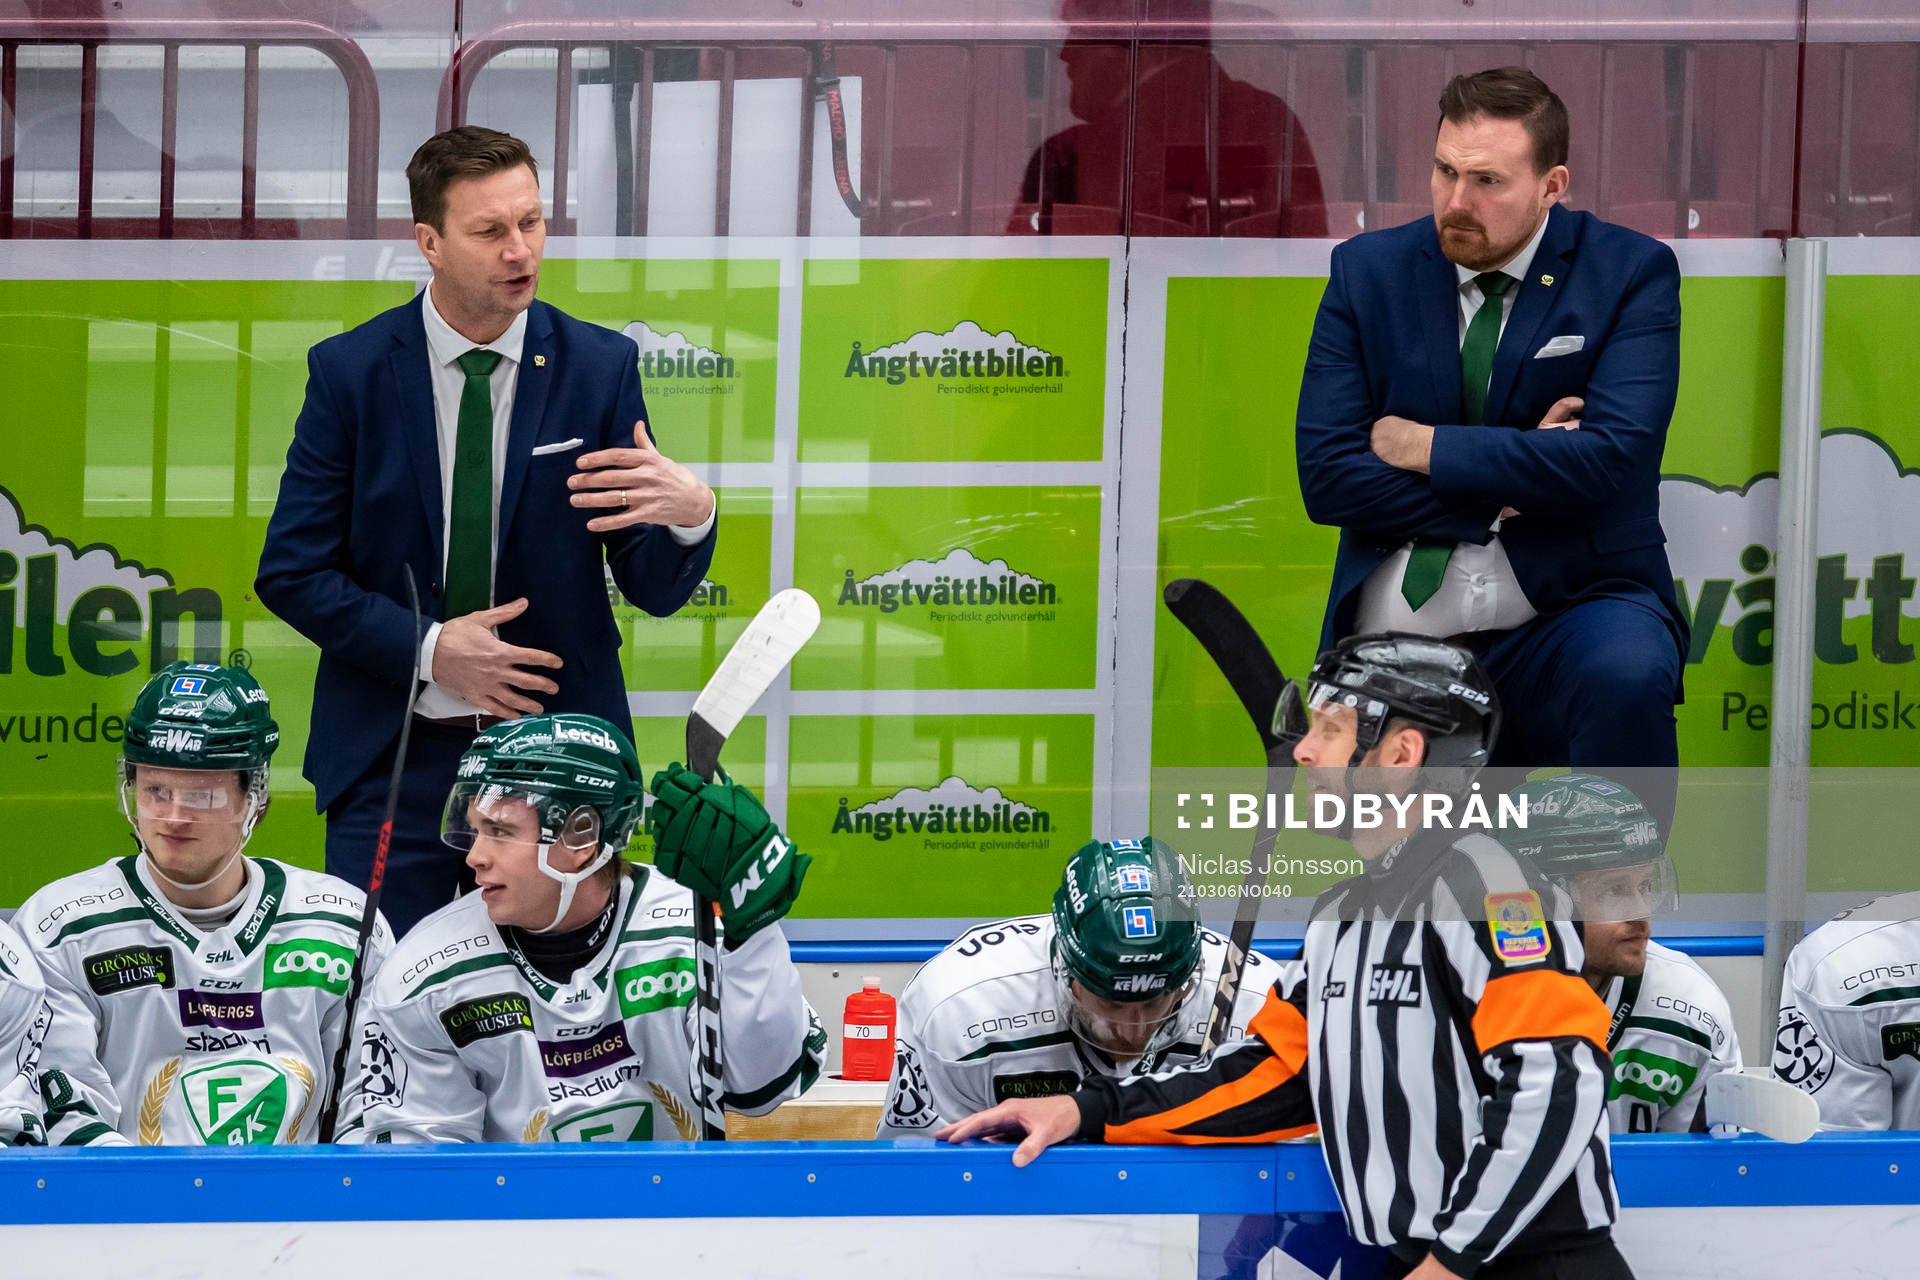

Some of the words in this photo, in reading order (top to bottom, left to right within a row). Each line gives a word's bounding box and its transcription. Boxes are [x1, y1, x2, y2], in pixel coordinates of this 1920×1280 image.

[844, 340, 1064, 385] Ångtvättbilen
[937, 383, 990, 394] Periodiskt
[993, 383, 1063, 396] golvunderhåll
[837, 569, 1056, 613] Ångtvättbilen
[930, 611, 982, 622] Periodiskt
[985, 611, 1056, 624] golvunderhåll
[1448, 683, 1490, 705] CCM
[554, 722, 621, 755] Lecab
[574, 774, 616, 790] CCM
[831, 797, 1050, 842] Ångtvättbilen
[1066, 856, 1090, 915] Lecab
[244, 894, 276, 944] stadium
[205, 950, 235, 964] SHL
[273, 950, 352, 984] coop
[1118, 952, 1163, 964] CCM
[199, 979, 244, 990] CCM
[625, 970, 696, 1003] coop
[1369, 969, 1420, 1002] SHL
[698, 940, 726, 1134] CCM
[855, 1026, 871, 1038] 70
[544, 1035, 624, 1068] LÖFBERGS
[547, 1063, 642, 1103] stadium
